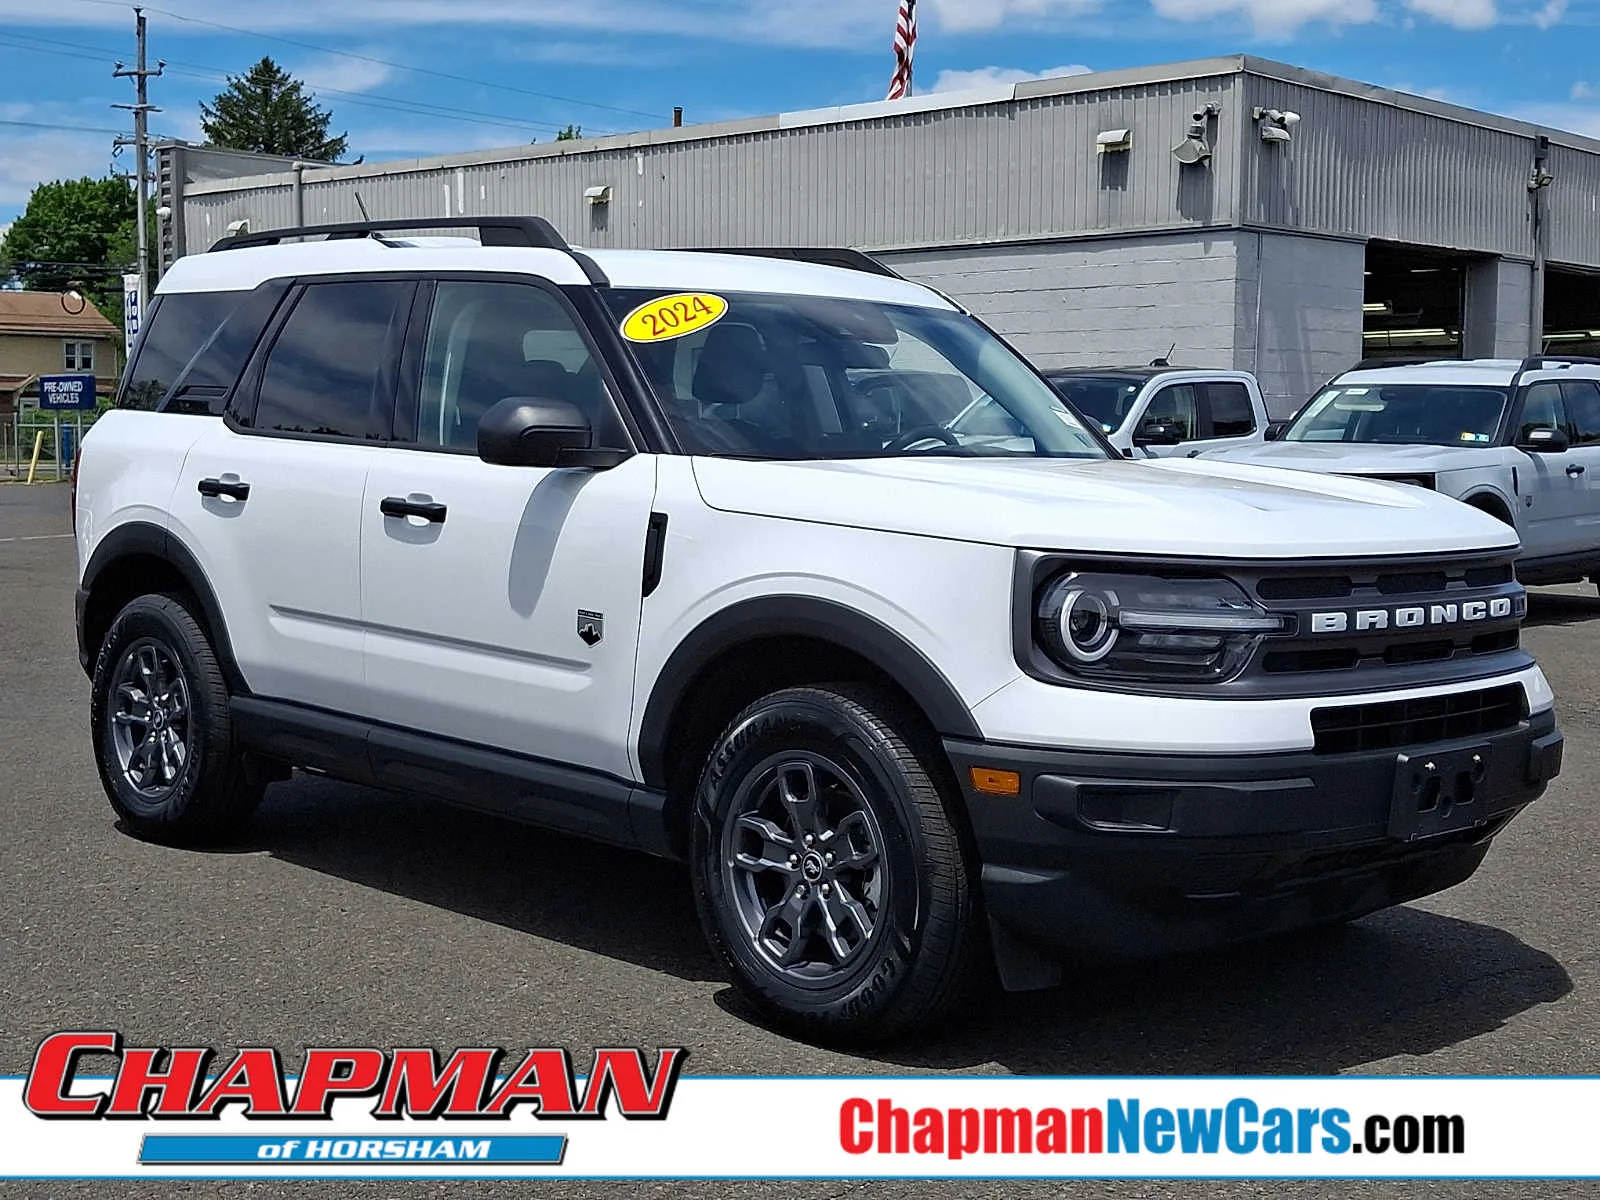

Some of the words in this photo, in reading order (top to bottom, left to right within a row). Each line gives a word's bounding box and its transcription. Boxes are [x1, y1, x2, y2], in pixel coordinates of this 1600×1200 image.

[641, 296, 713, 336] 2024
[43, 381, 83, 392] PRE-OWNED
[48, 392, 80, 404] VEHICLES
[1311, 597, 1511, 633] BRONCO
